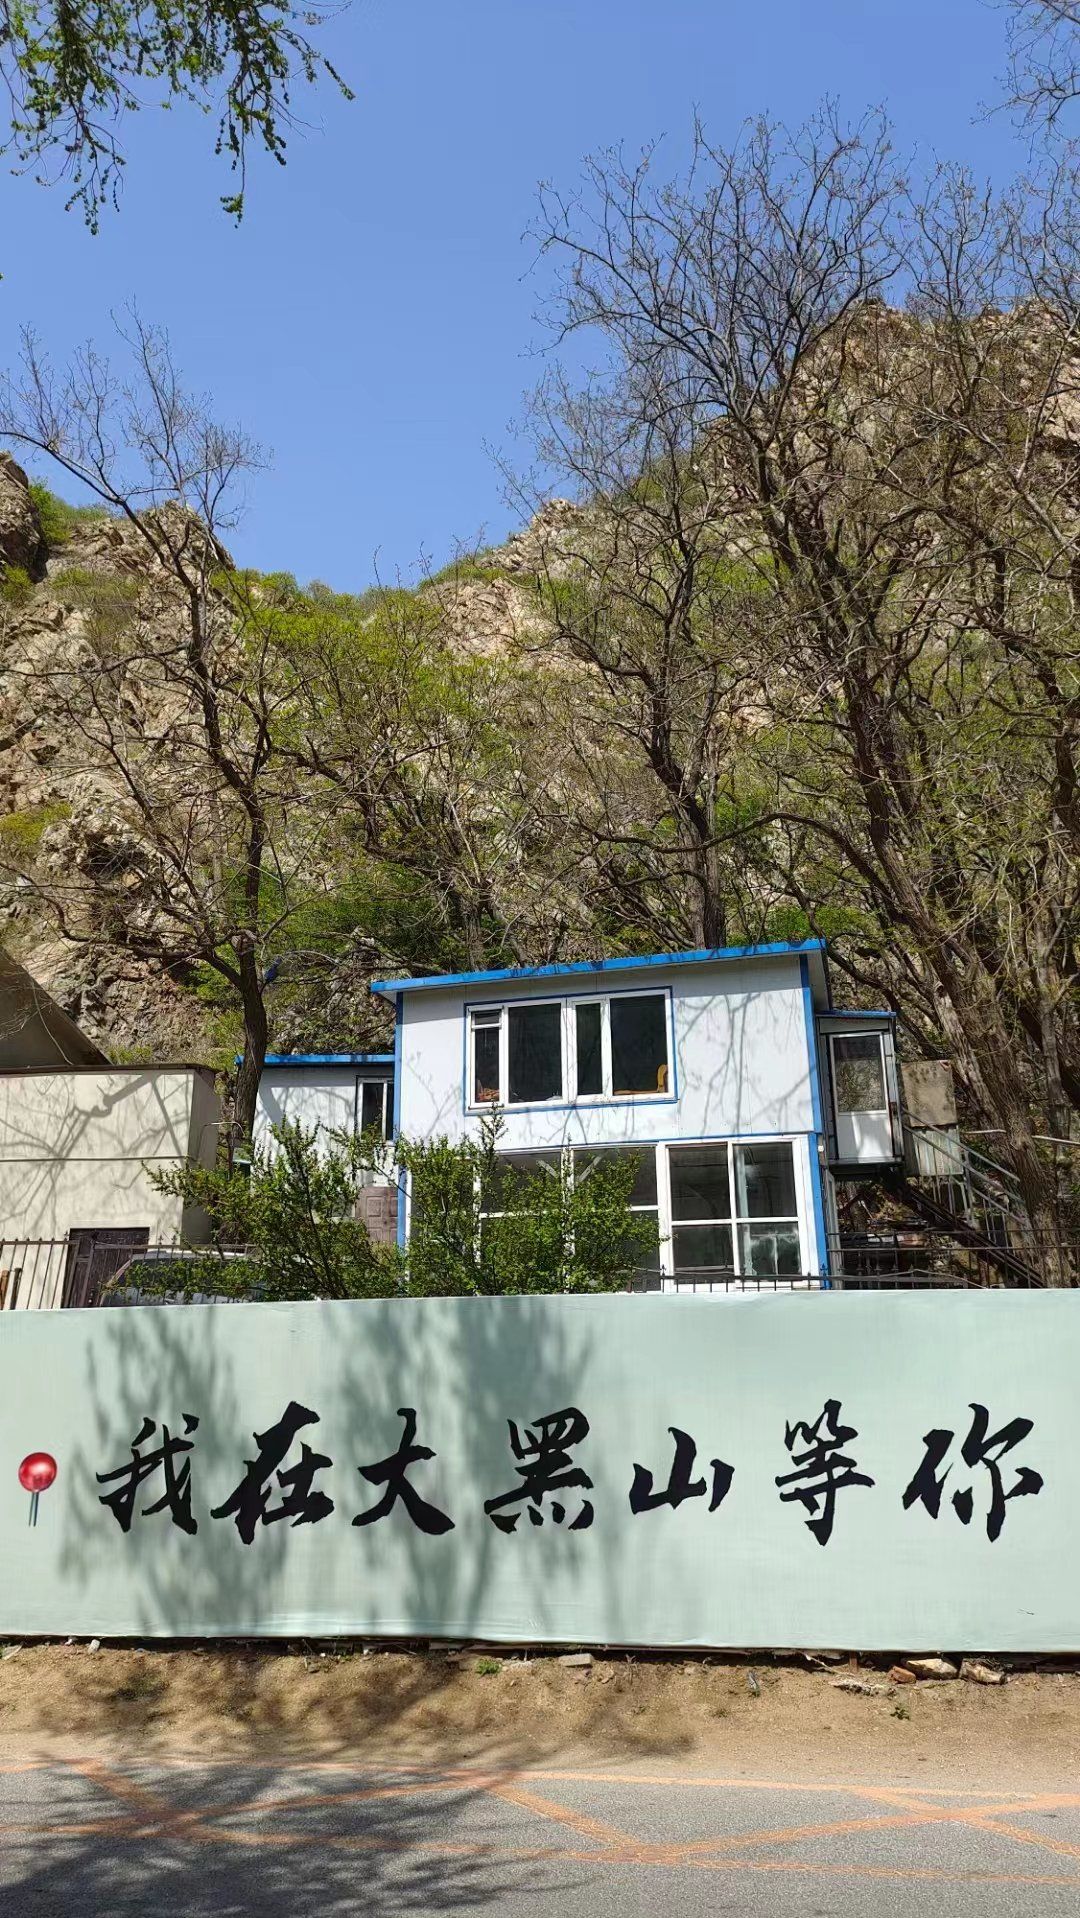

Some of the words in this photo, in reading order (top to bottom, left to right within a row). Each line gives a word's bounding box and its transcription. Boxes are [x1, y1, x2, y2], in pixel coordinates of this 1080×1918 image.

[95, 1398, 1044, 1547] 我在大黑山等你
